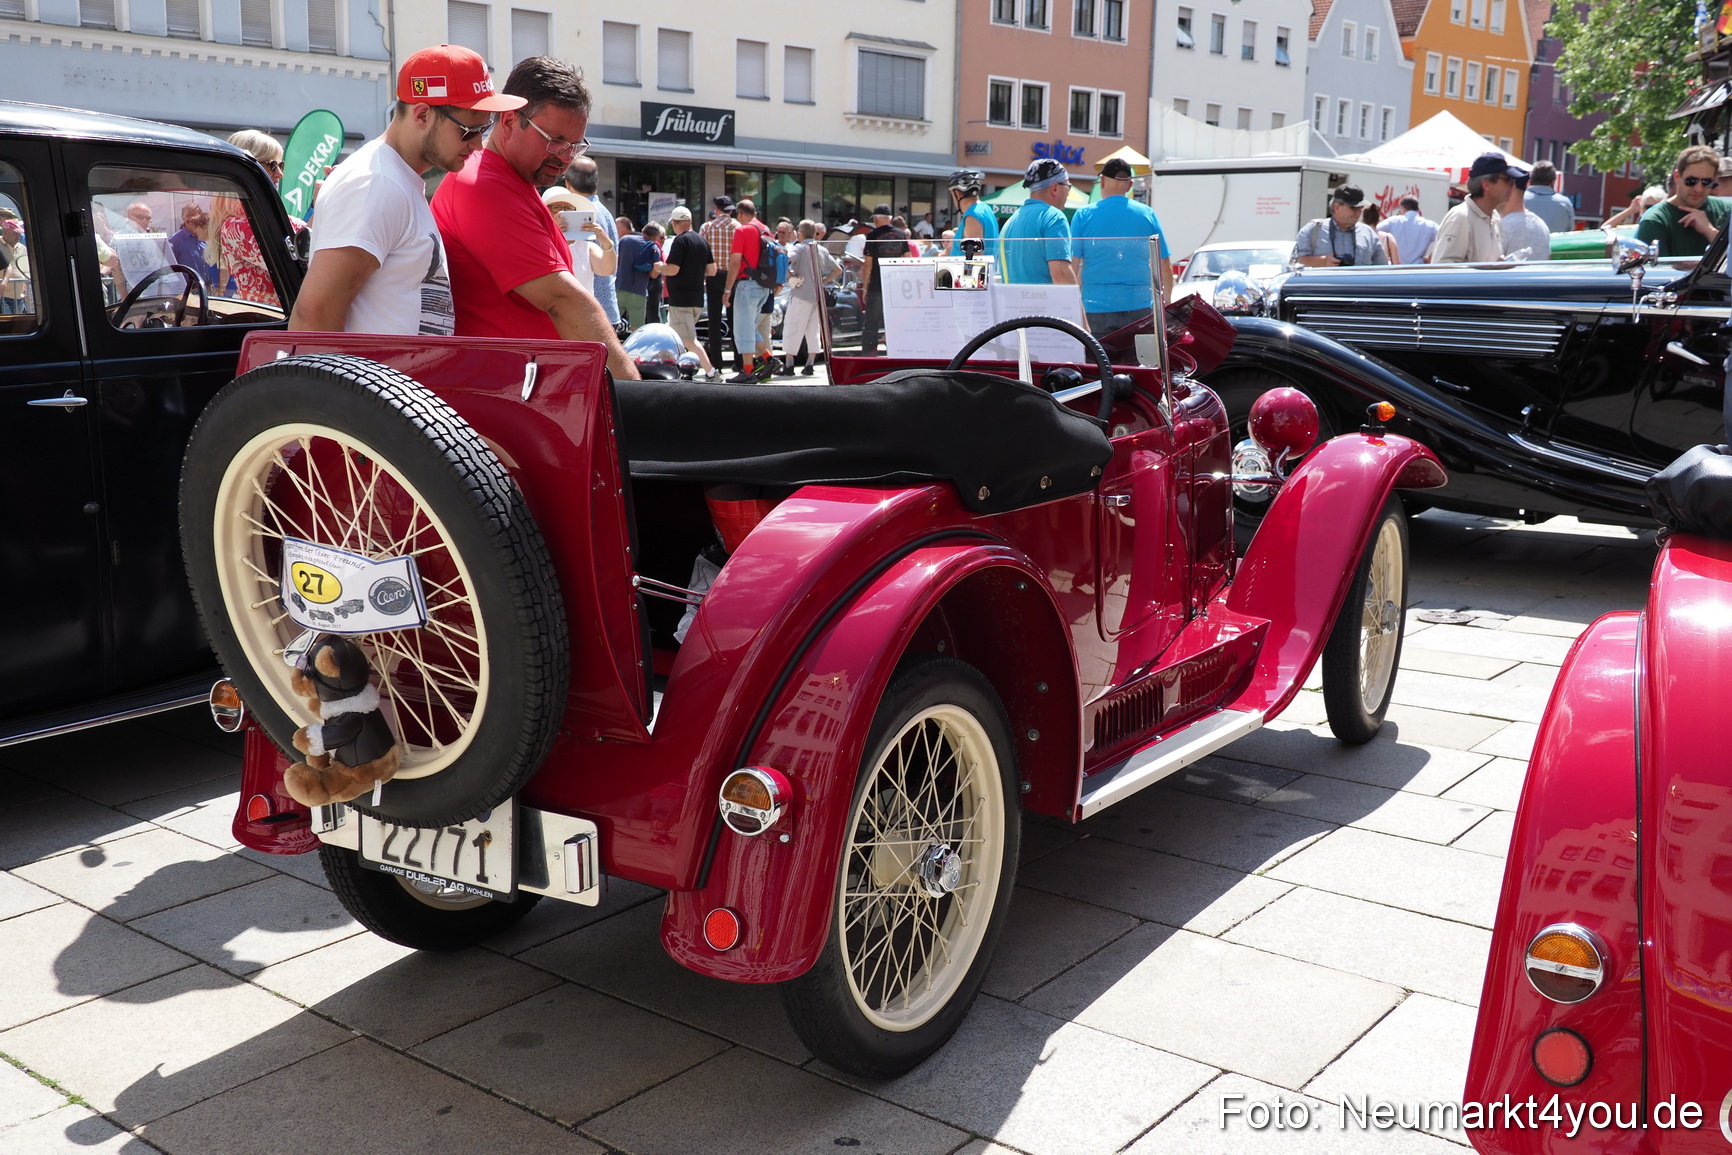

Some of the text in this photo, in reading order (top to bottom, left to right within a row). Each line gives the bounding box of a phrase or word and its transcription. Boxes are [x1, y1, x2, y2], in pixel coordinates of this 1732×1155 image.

[473, 80, 495, 94] DEK
[647, 107, 733, 142] frühauf
[298, 133, 340, 187] DEKRA
[1000, 205, 1019, 214] DEKR
[332, 554, 366, 571] Freunde
[299, 570, 324, 596] 27
[377, 588, 406, 606] Aero
[382, 826, 489, 884] 22771
[380, 865, 405, 876] GARAGE
[449, 882, 465, 892] AG
[466, 886, 493, 899] WOHLEN
